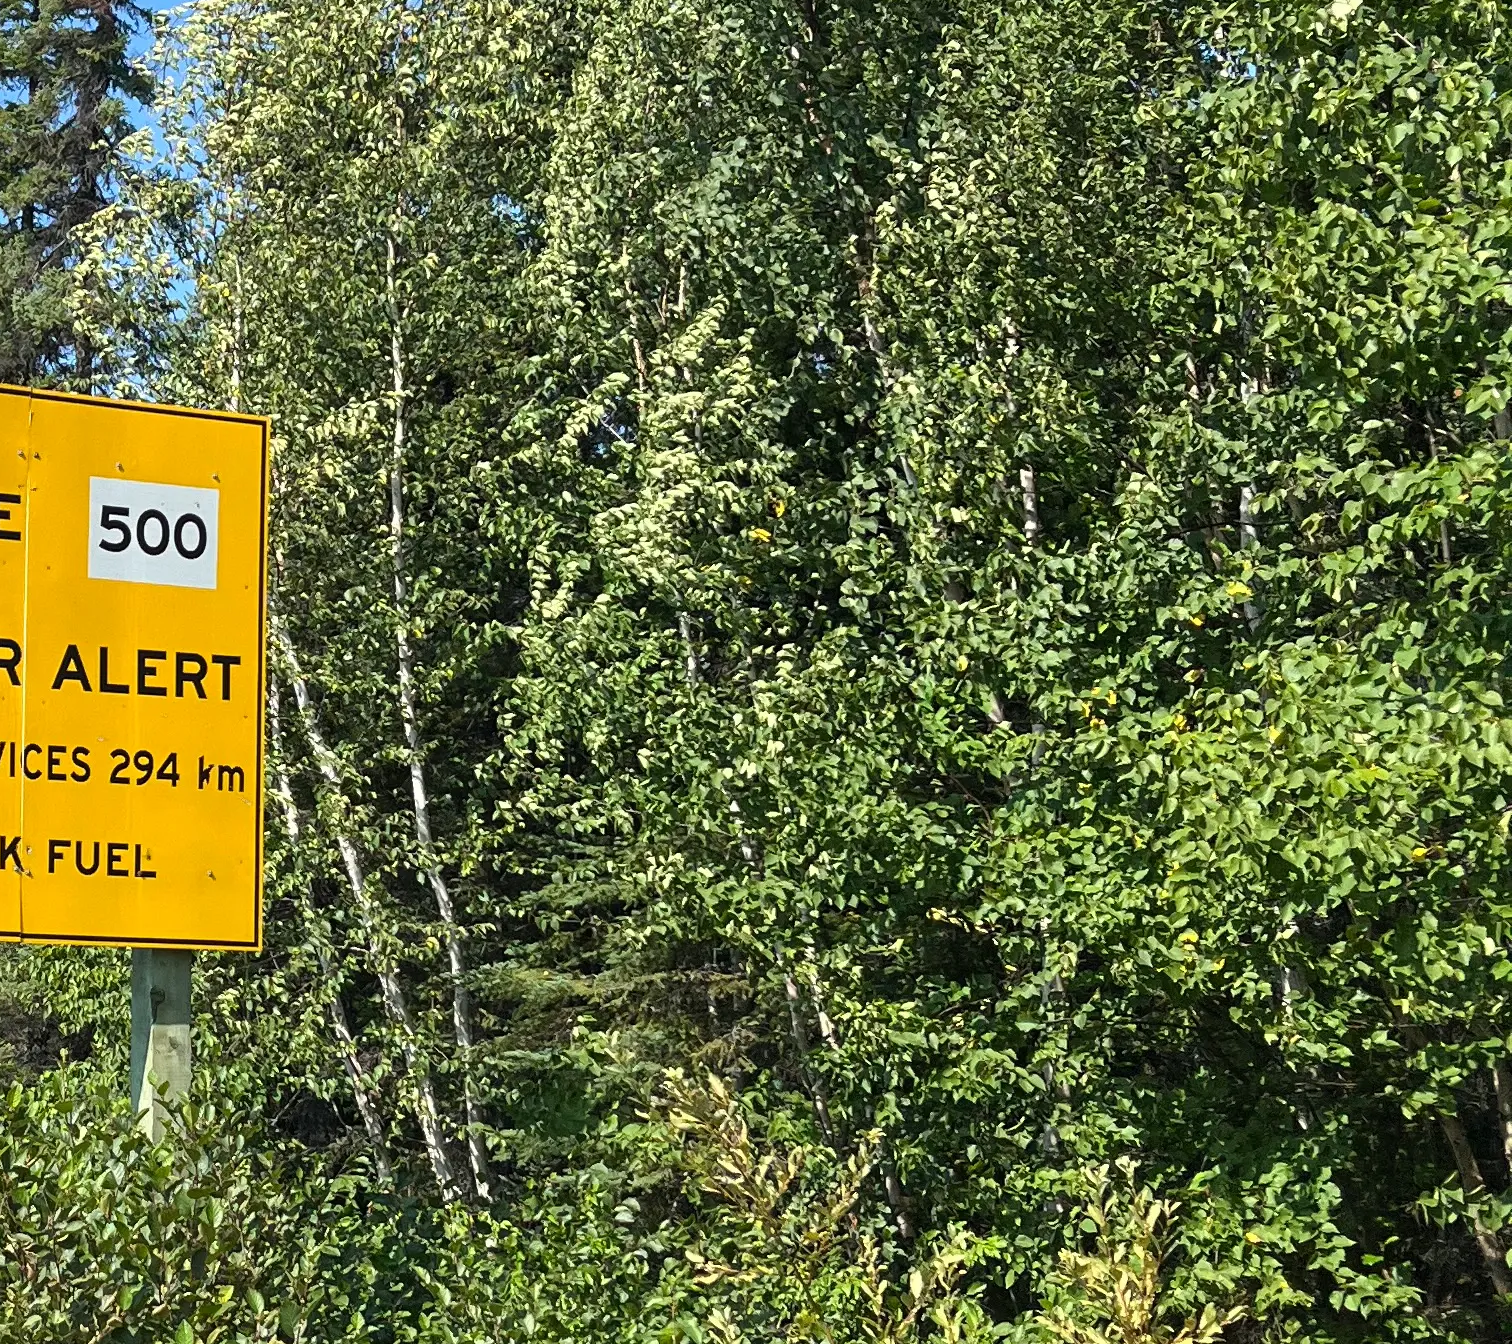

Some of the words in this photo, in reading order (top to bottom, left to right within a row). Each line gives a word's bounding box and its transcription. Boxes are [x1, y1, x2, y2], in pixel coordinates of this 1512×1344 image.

[98, 504, 208, 560] 500
[51, 644, 241, 701] ALERT
[109, 748, 180, 788] 294
[198, 755, 246, 794] km
[48, 839, 158, 879] FUEL
